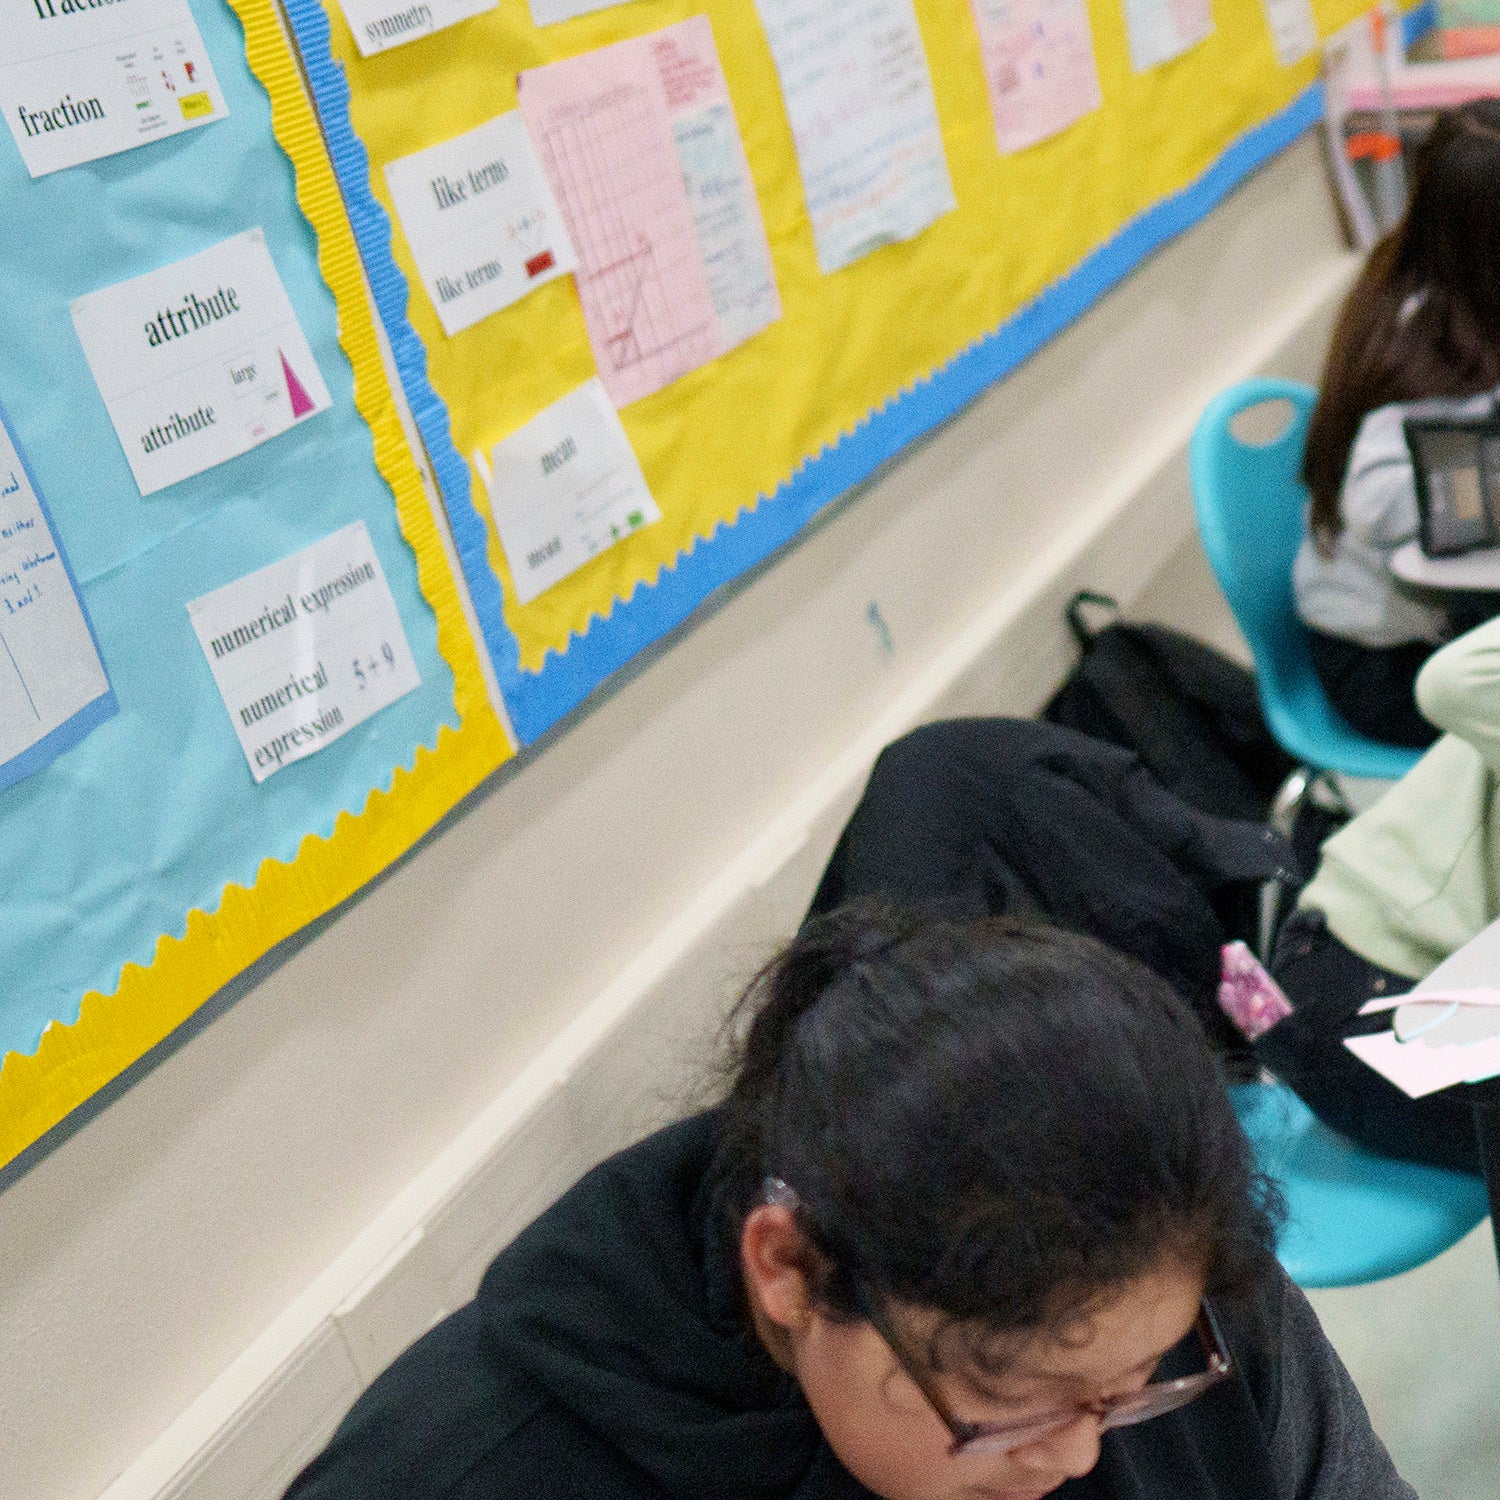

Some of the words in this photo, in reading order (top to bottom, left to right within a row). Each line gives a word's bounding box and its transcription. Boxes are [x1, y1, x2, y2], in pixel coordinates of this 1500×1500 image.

[17, 94, 107, 137] fraction
[430, 173, 467, 211] like
[467, 157, 510, 196] terms
[434, 274, 466, 304] like
[466, 259, 503, 291] terms
[143, 284, 242, 348] attribute
[139, 403, 218, 454] attribute
[210, 594, 299, 659] numerical
[300, 560, 377, 614] expression
[239, 660, 330, 729] numerical
[253, 705, 345, 767] expression
